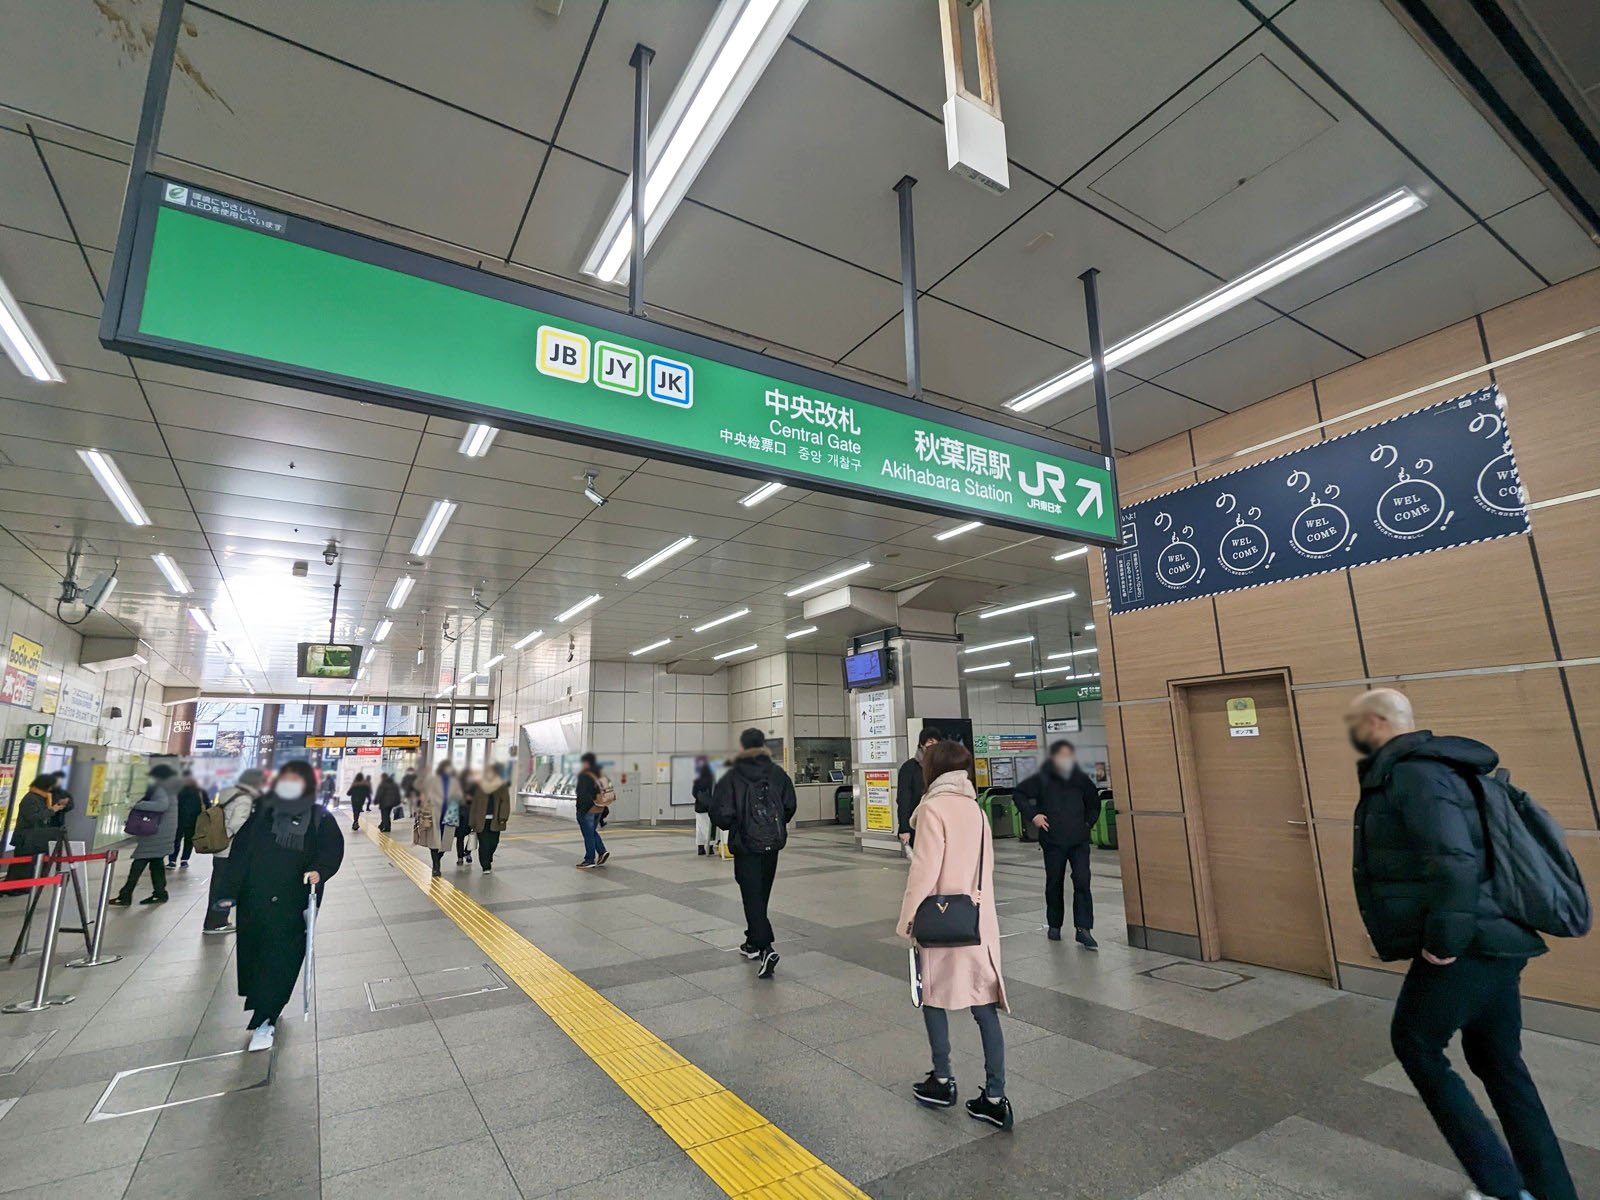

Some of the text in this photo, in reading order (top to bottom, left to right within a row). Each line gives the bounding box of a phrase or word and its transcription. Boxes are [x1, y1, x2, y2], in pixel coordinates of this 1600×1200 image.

[190, 200, 282, 231] LEDを使用しています
[549, 343, 577, 366] JB
[605, 357, 633, 379] JY
[657, 371, 683, 393] JK
[765, 388, 861, 435] 中央改札
[720, 428, 787, 456] 中央检票口
[769, 419, 861, 454] Central Gate
[798, 446, 862, 472] 중앙 개찰구
[914, 430, 1012, 482] 秋葉原駅
[880, 459, 1013, 504] Akihabara Station
[1018, 461, 1067, 503] JR
[1026, 498, 1063, 514] JR東日本
[1393, 494, 1421, 507] WEL
[1394, 503, 1431, 522] COME
[1305, 517, 1329, 528] WEL
[1231, 536, 1252, 547] WEL
[1306, 526, 1337, 543] COME
[1168, 553, 1186, 563] WEL
[1232, 545, 1259, 560] COME
[1168, 561, 1191, 575] COME
[1077, 687, 1089, 697] JR
[869, 704, 872, 712] 2
[869, 715, 873, 723] 3
[870, 741, 874, 749] 5
